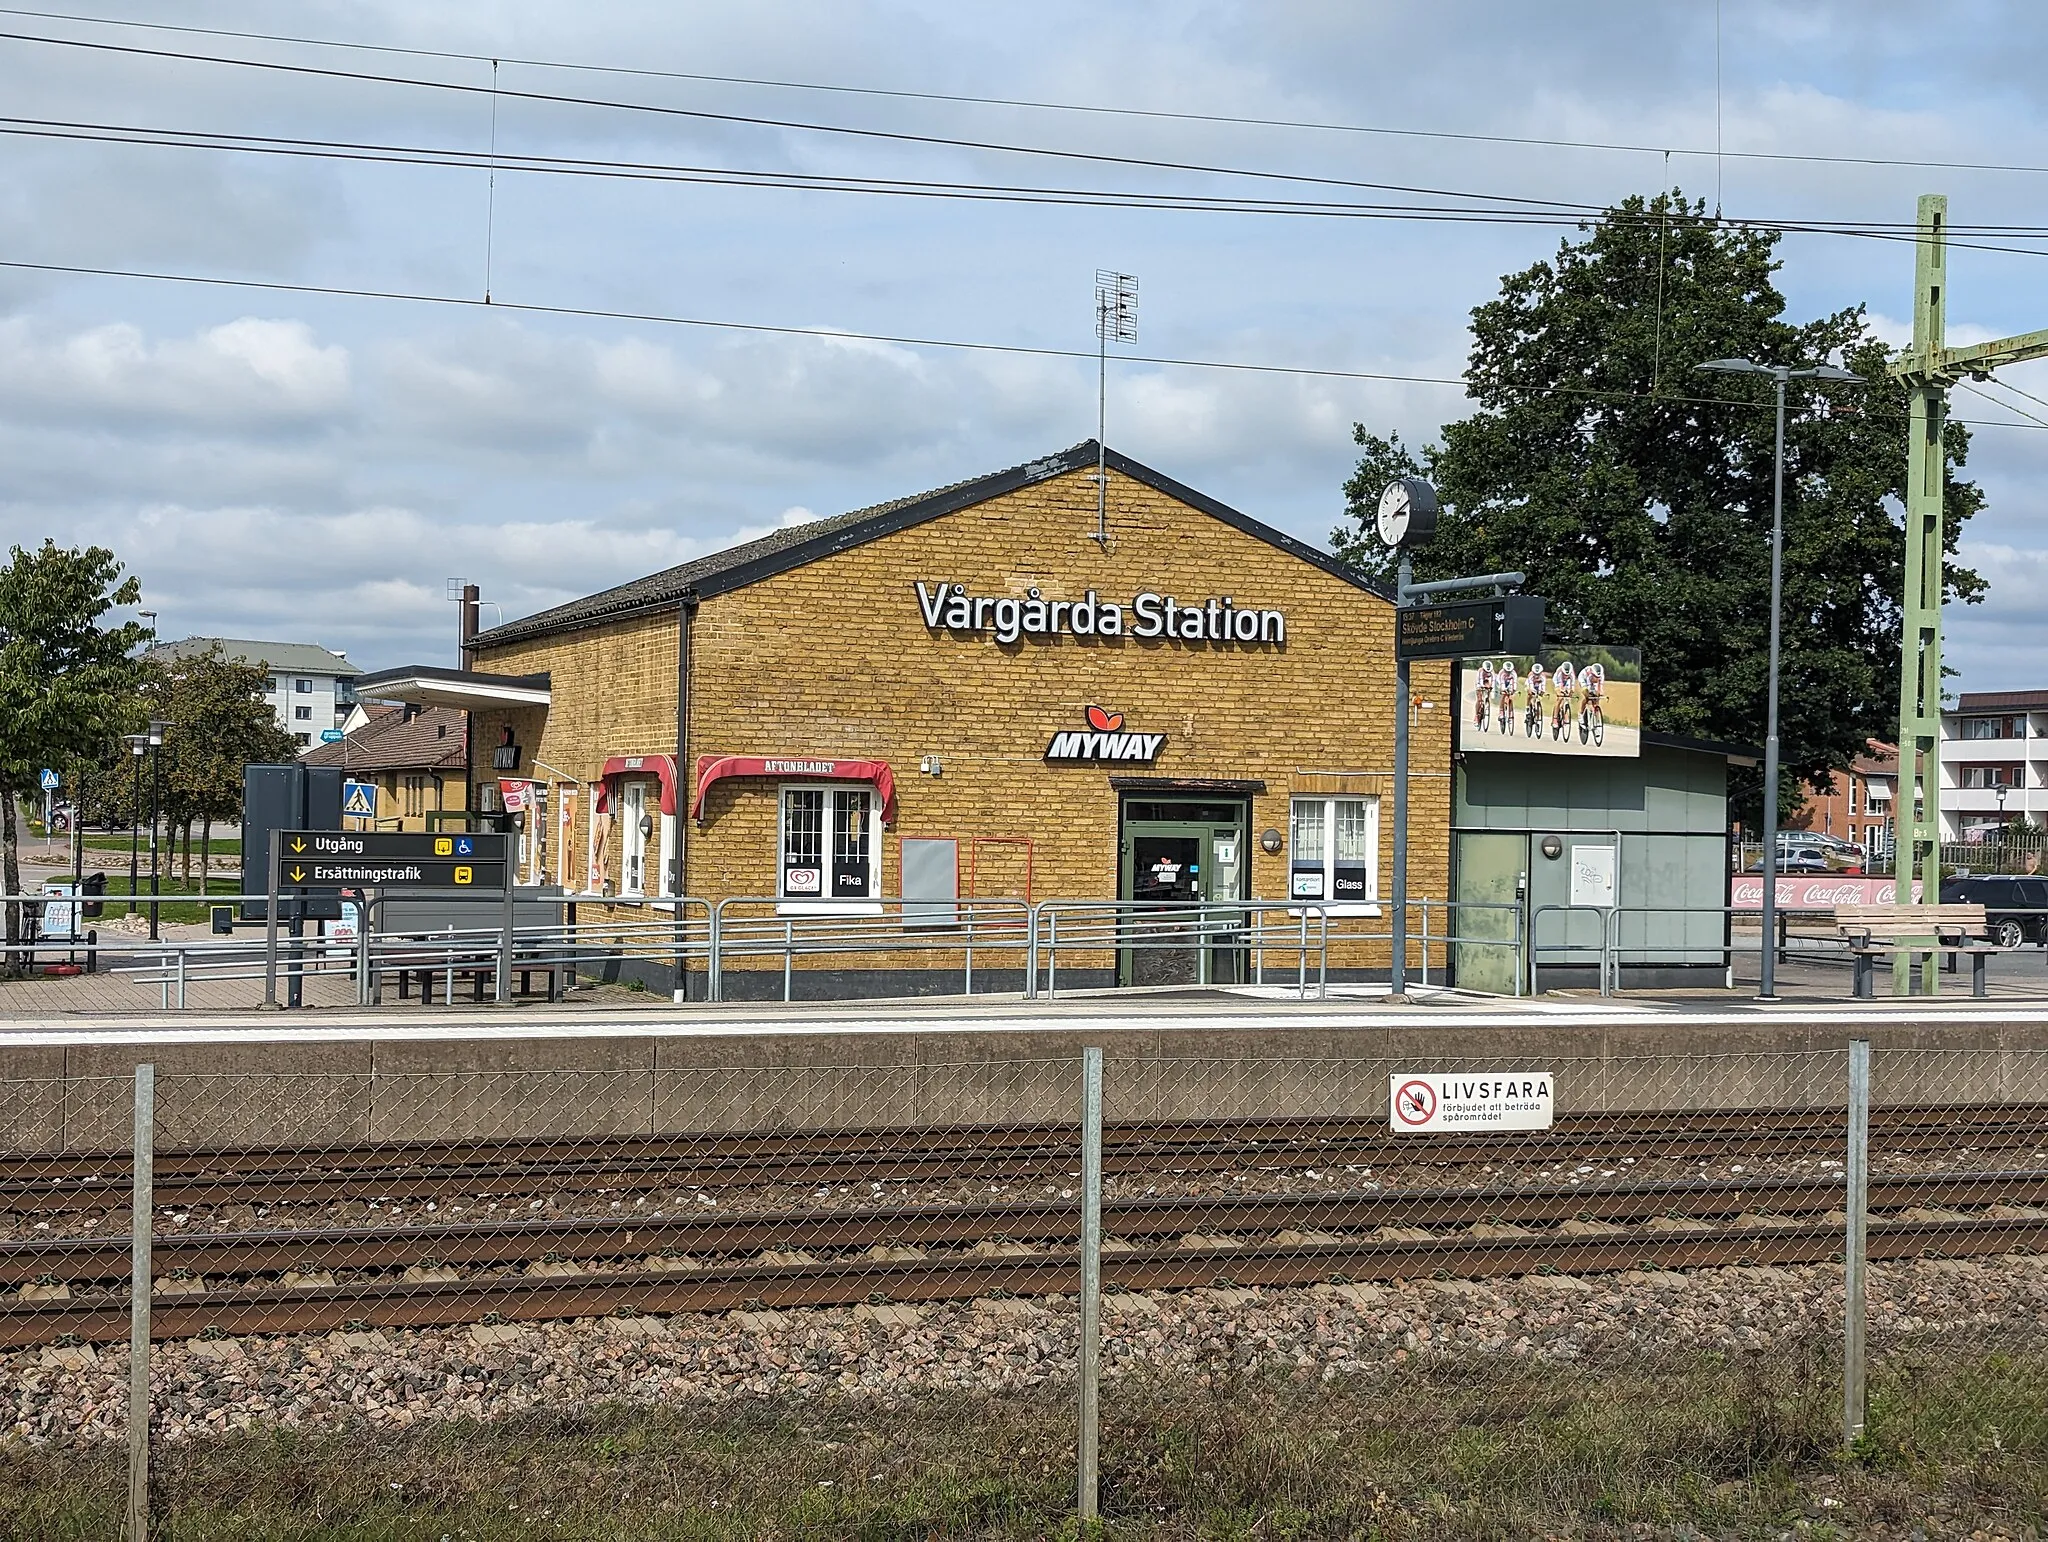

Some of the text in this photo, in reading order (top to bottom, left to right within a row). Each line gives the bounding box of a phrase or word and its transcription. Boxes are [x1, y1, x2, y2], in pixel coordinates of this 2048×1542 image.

[914, 582, 1285, 643] Vårgårda Station
[1402, 616, 1475, 635] Skövde Stockholm C
[1497, 623, 1504, 642] 1
[1047, 732, 1164, 760] MYWAY
[765, 760, 835, 773] AFTONBLADET
[315, 836, 364, 854] Utgång
[314, 866, 422, 883] Ersättningstrafik
[1151, 863, 1182, 872] MYWAY
[839, 875, 862, 886] Fika
[1336, 878, 1363, 890] Glass
[1442, 1081, 1549, 1100] LIVSFARA
[1442, 1102, 1541, 1113] förbjudet att beträda
[1442, 1113, 1502, 1122] spårområdet
